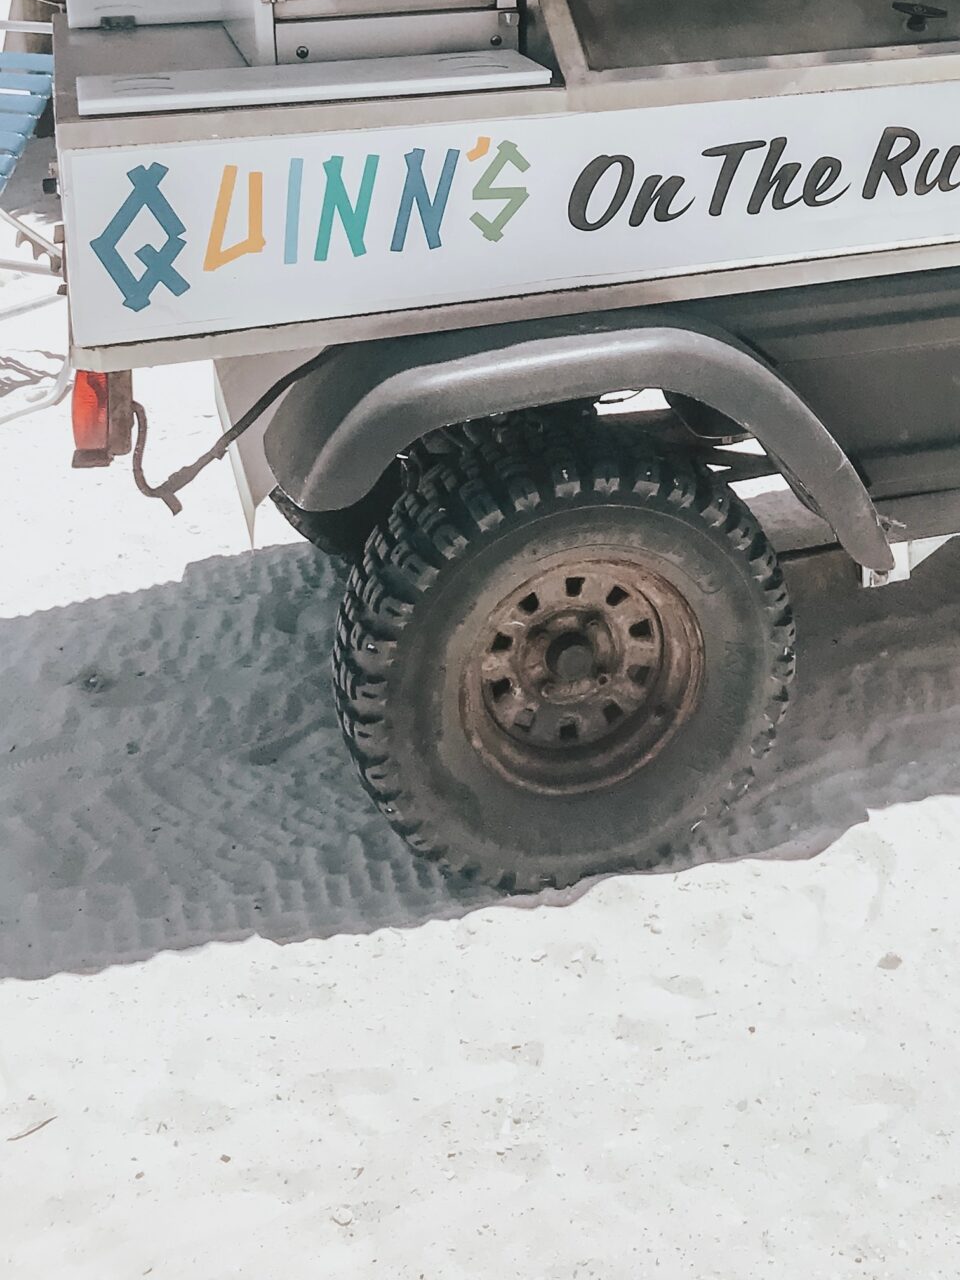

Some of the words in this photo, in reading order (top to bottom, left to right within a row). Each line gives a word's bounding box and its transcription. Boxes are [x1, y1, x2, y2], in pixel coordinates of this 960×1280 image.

[90, 136, 532, 312] QUINN'S
[567, 154, 696, 232] On
[701, 136, 851, 217] The
